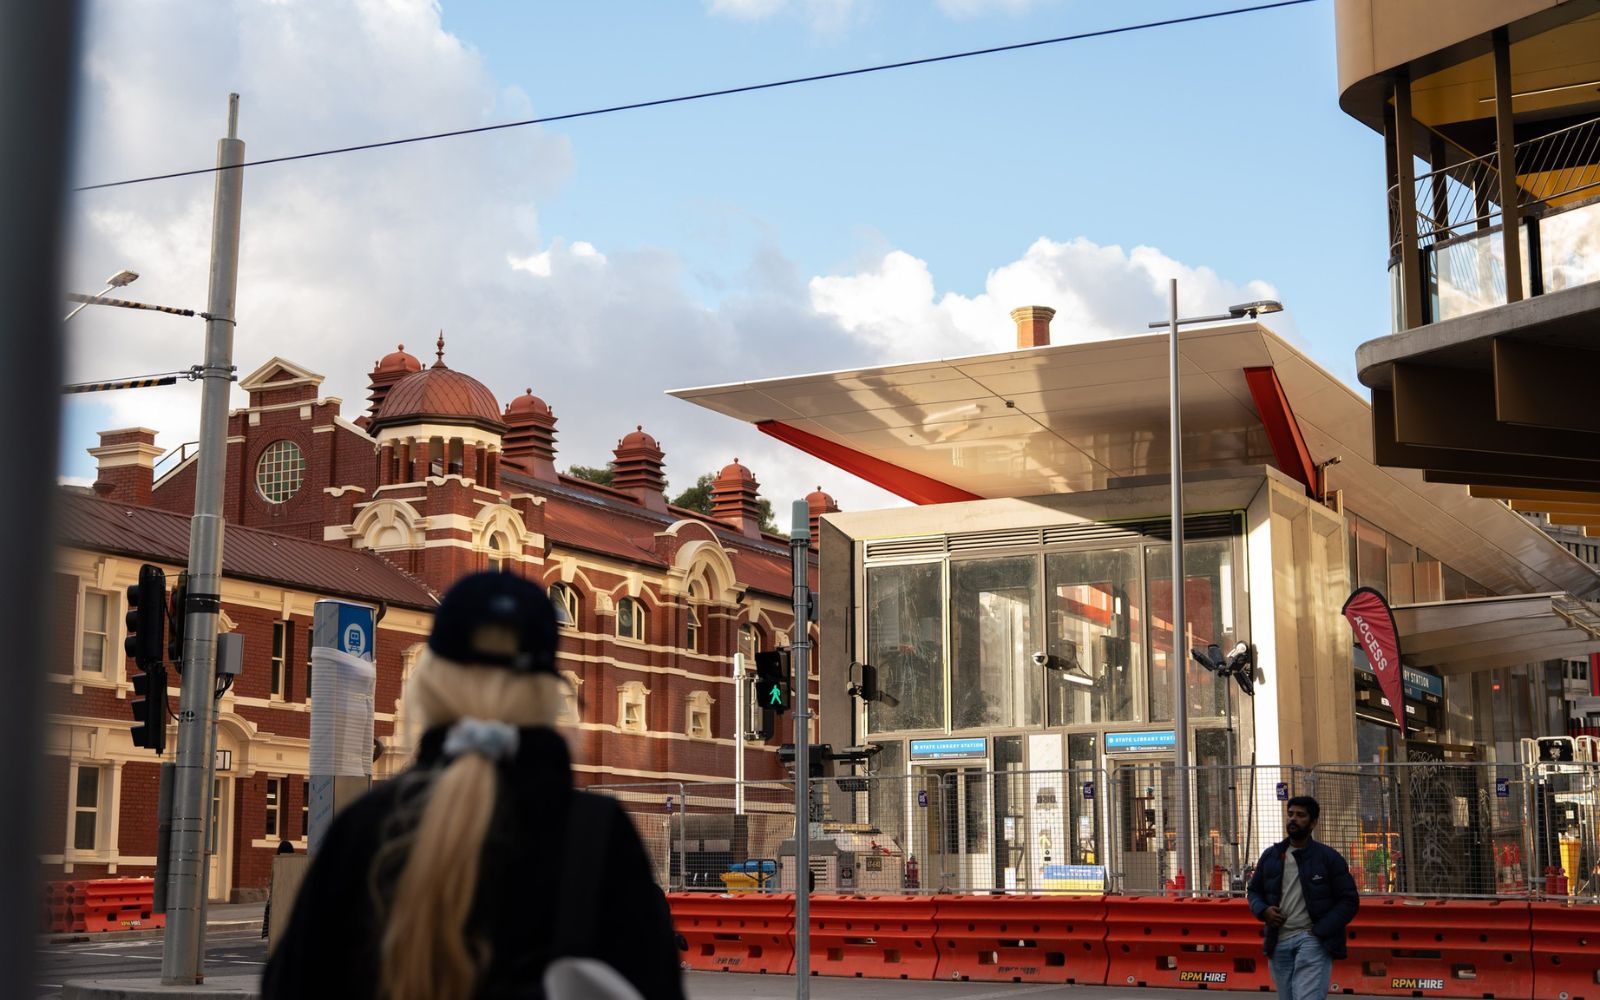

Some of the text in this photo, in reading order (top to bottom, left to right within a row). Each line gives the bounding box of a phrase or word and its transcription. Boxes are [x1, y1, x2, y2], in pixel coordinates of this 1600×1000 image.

[1353, 615, 1388, 671] ACCESS
[1180, 971, 1227, 982] RPM HIRE
[1392, 978, 1444, 989] RPM HIRE
